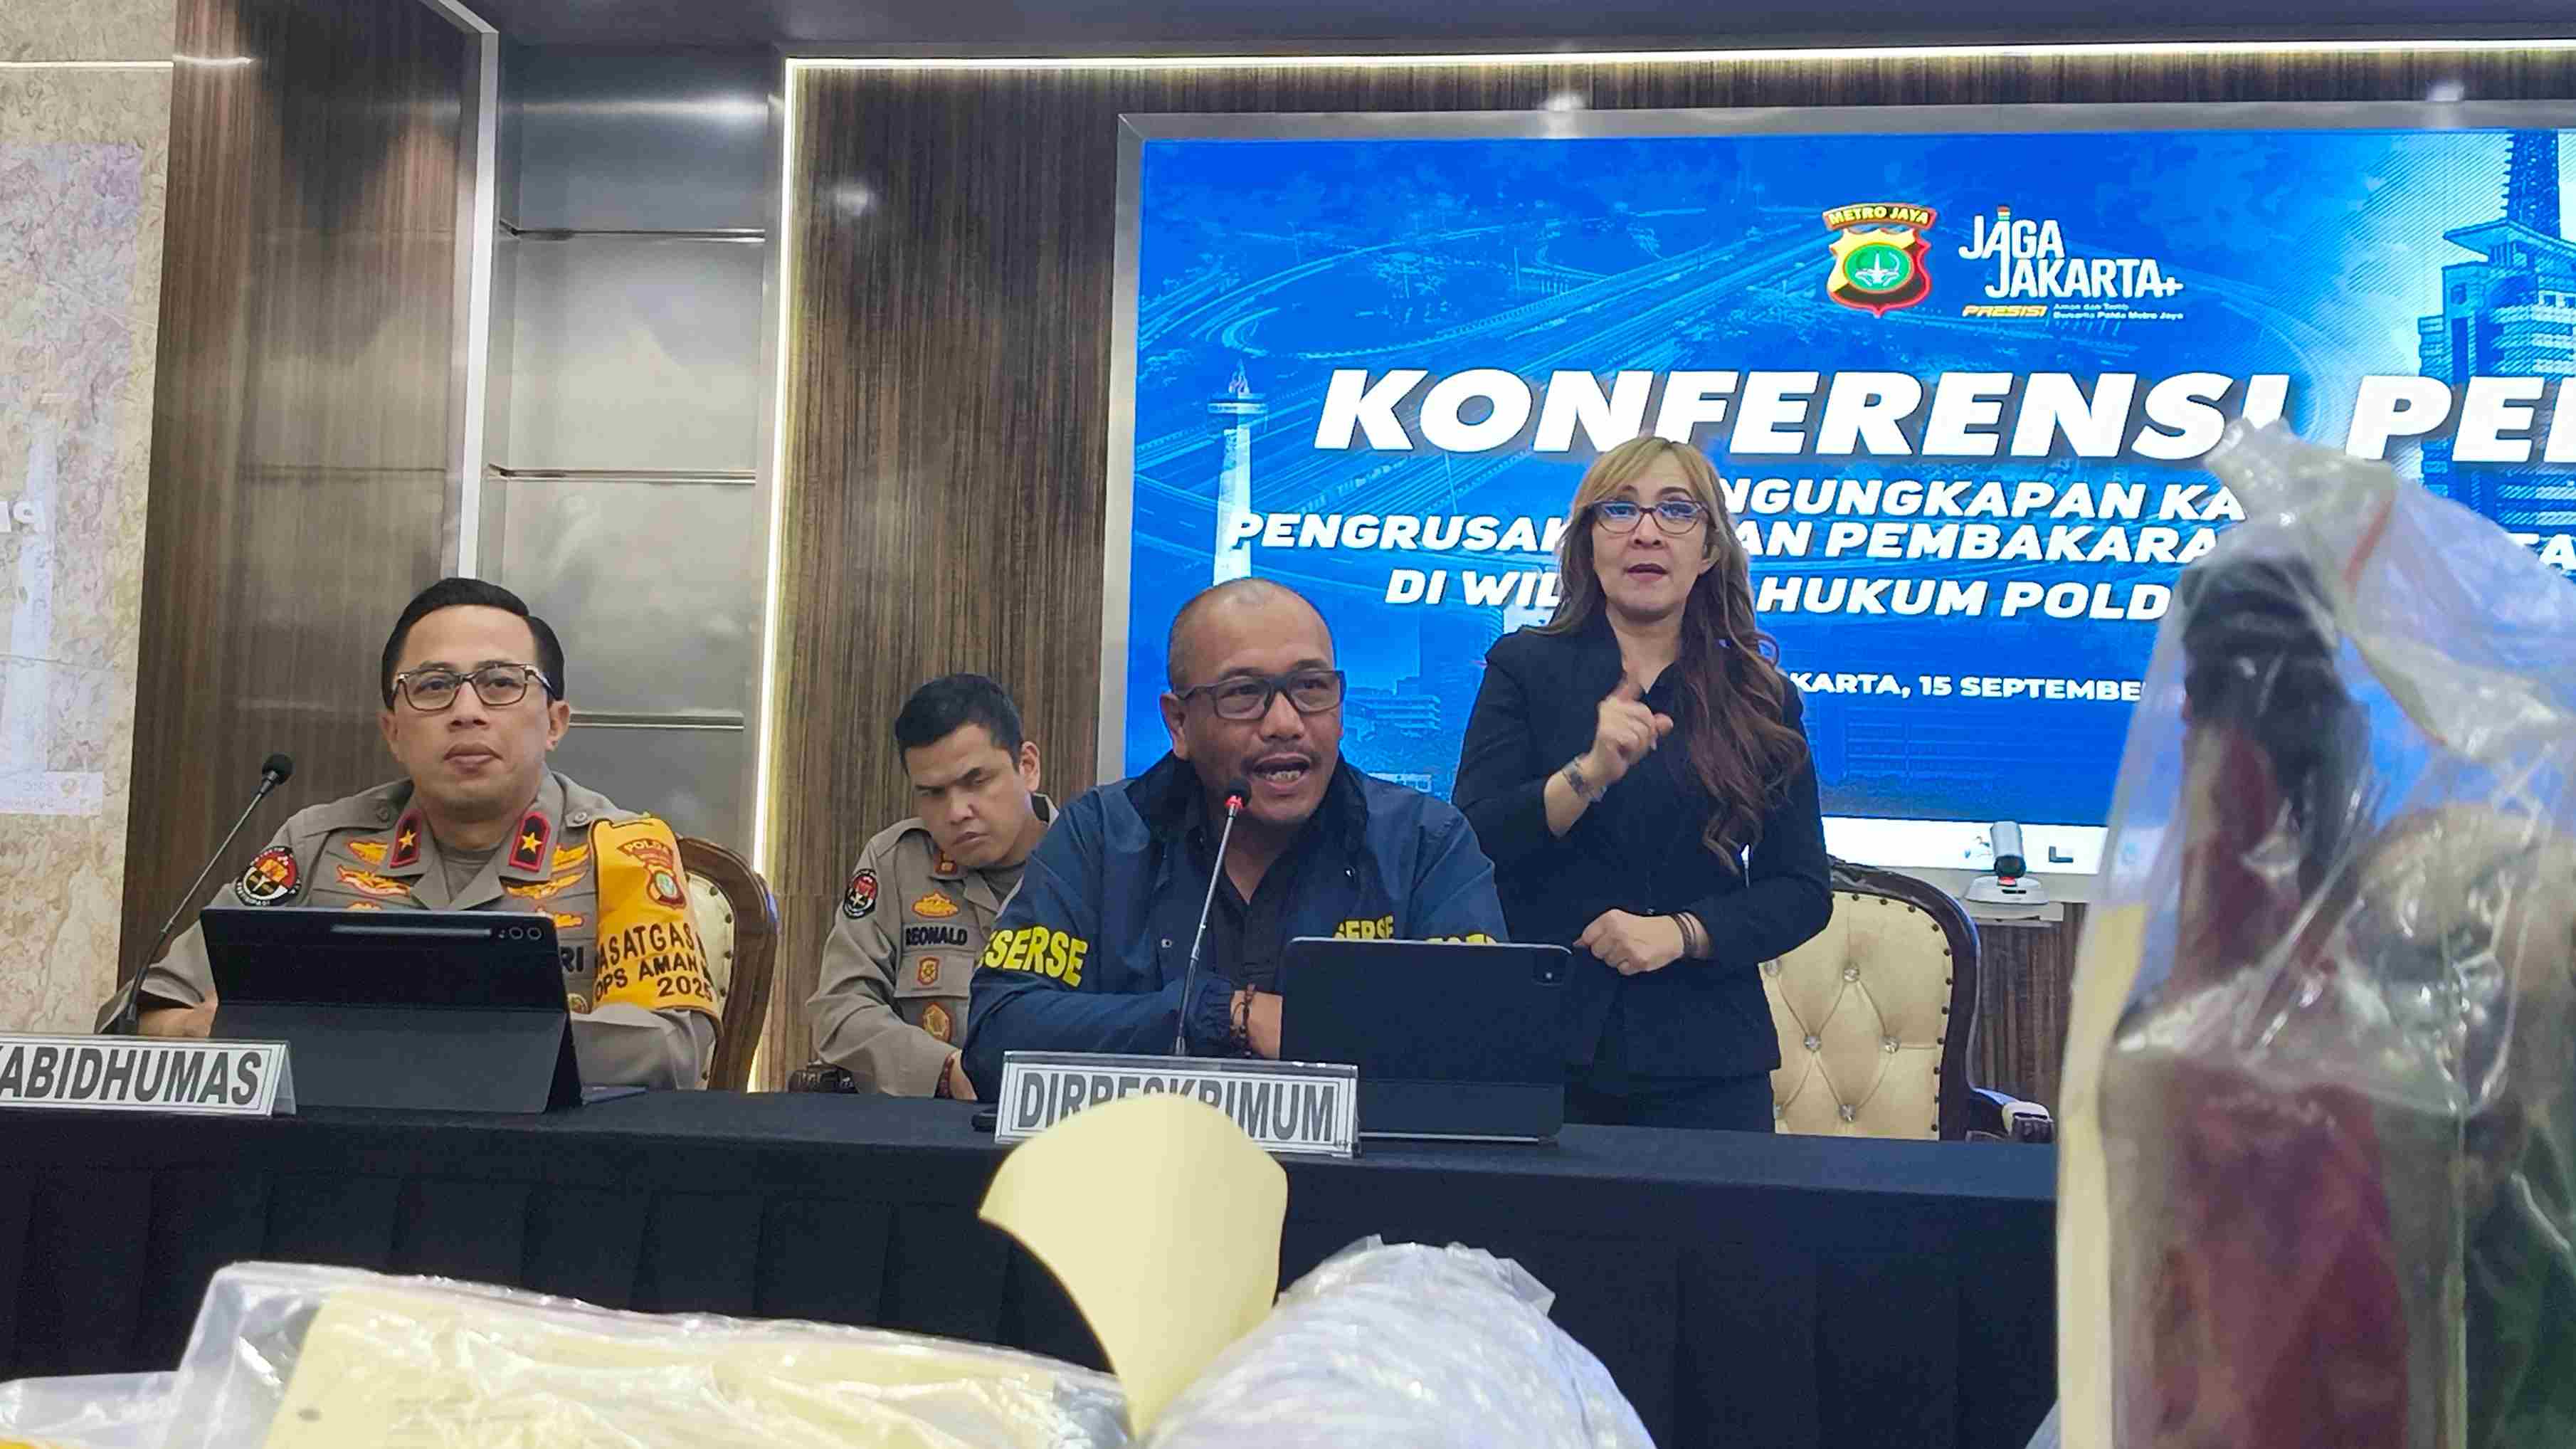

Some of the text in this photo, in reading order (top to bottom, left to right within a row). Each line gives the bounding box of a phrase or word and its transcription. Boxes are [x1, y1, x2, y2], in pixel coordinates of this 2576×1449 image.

[1828, 206, 1929, 225] METRO JAYA
[1958, 214, 2065, 259] JAGA
[1314, 368, 2291, 460] KONFERENSI
[1719, 477, 2247, 521] NGUNGKAPAN KA
[1230, 511, 2217, 564] PENGRUSAK AN PEMBAKARA
[1385, 570, 2172, 621] DI WIL HUKUM POLD
[1789, 672, 2144, 702] KARTA, 15 SEPTEMBE
[598, 922, 695, 971] ASATGAS
[978, 925, 1089, 988] SERSE
[594, 967, 628, 1002] OPS
[657, 974, 713, 1003] 2025
[0, 1045, 263, 1106] ABIDHUMAS
